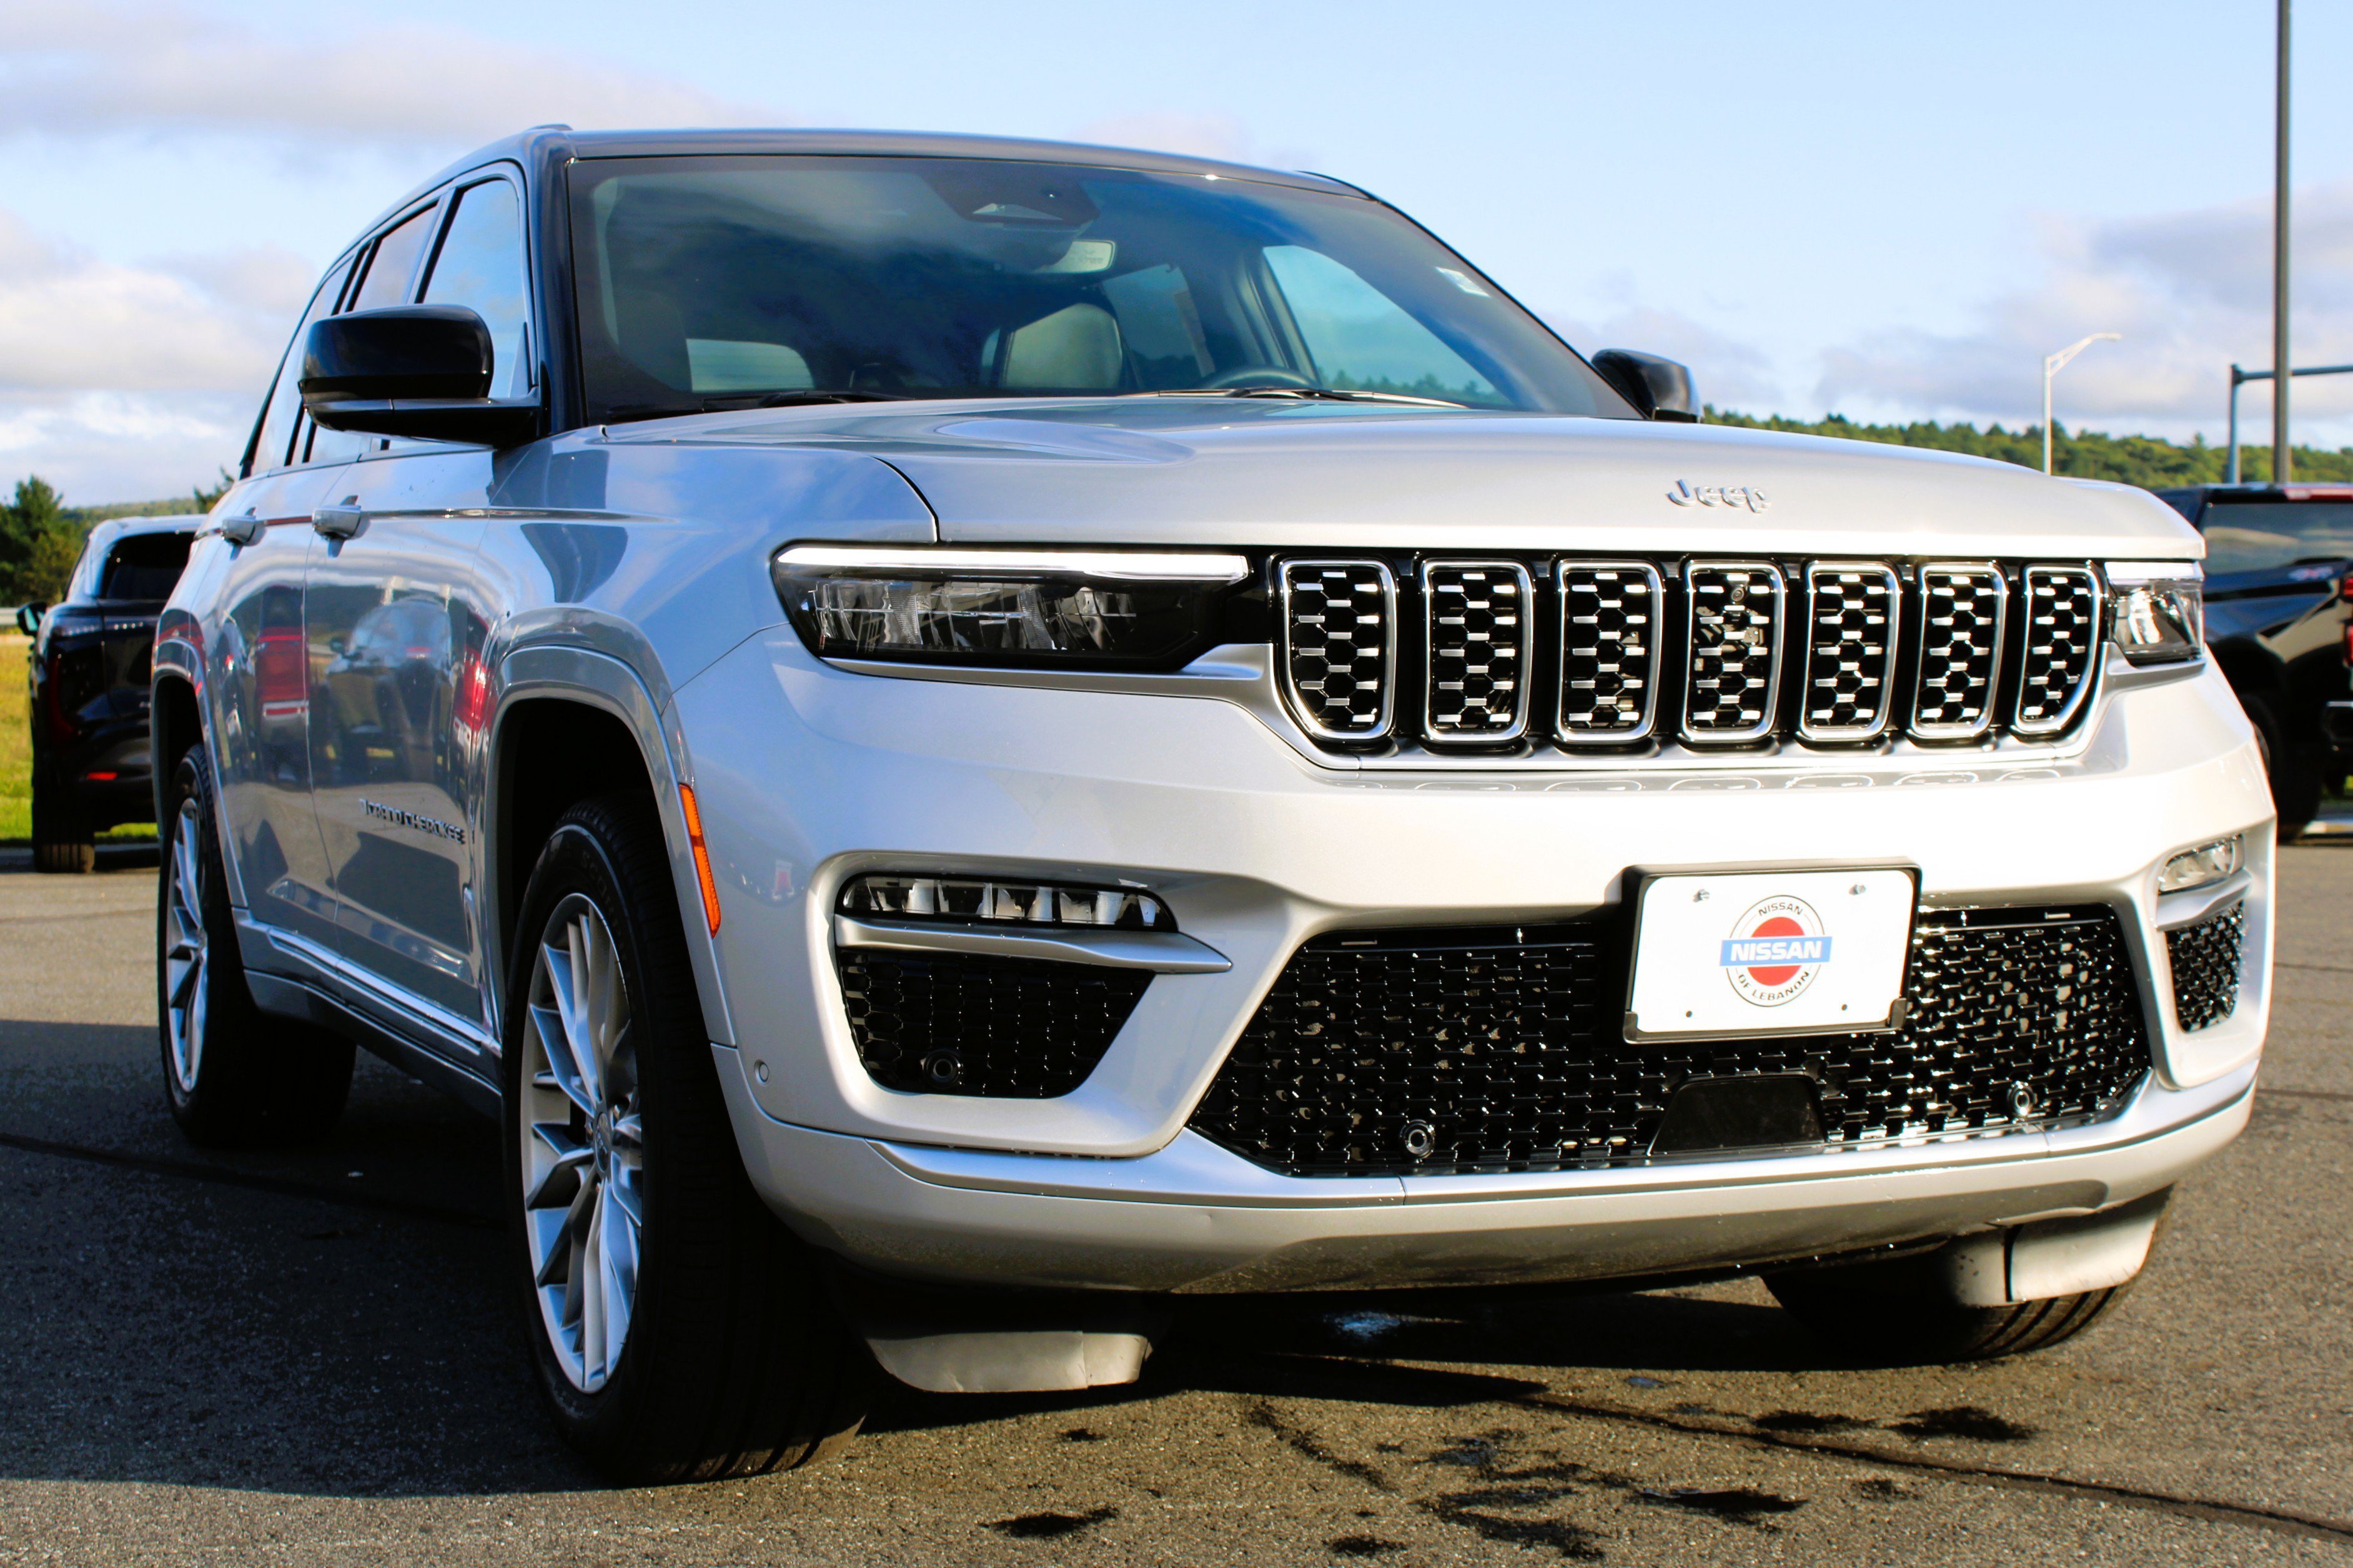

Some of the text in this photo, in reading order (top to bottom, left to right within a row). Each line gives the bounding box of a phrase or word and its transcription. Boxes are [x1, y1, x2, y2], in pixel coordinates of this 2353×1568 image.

[1665, 478, 1772, 514] Jeep
[1758, 902, 1803, 916] NISSAN
[1730, 940, 1822, 962] NISSAN
[1738, 971, 1810, 1001] OF LEBANON
